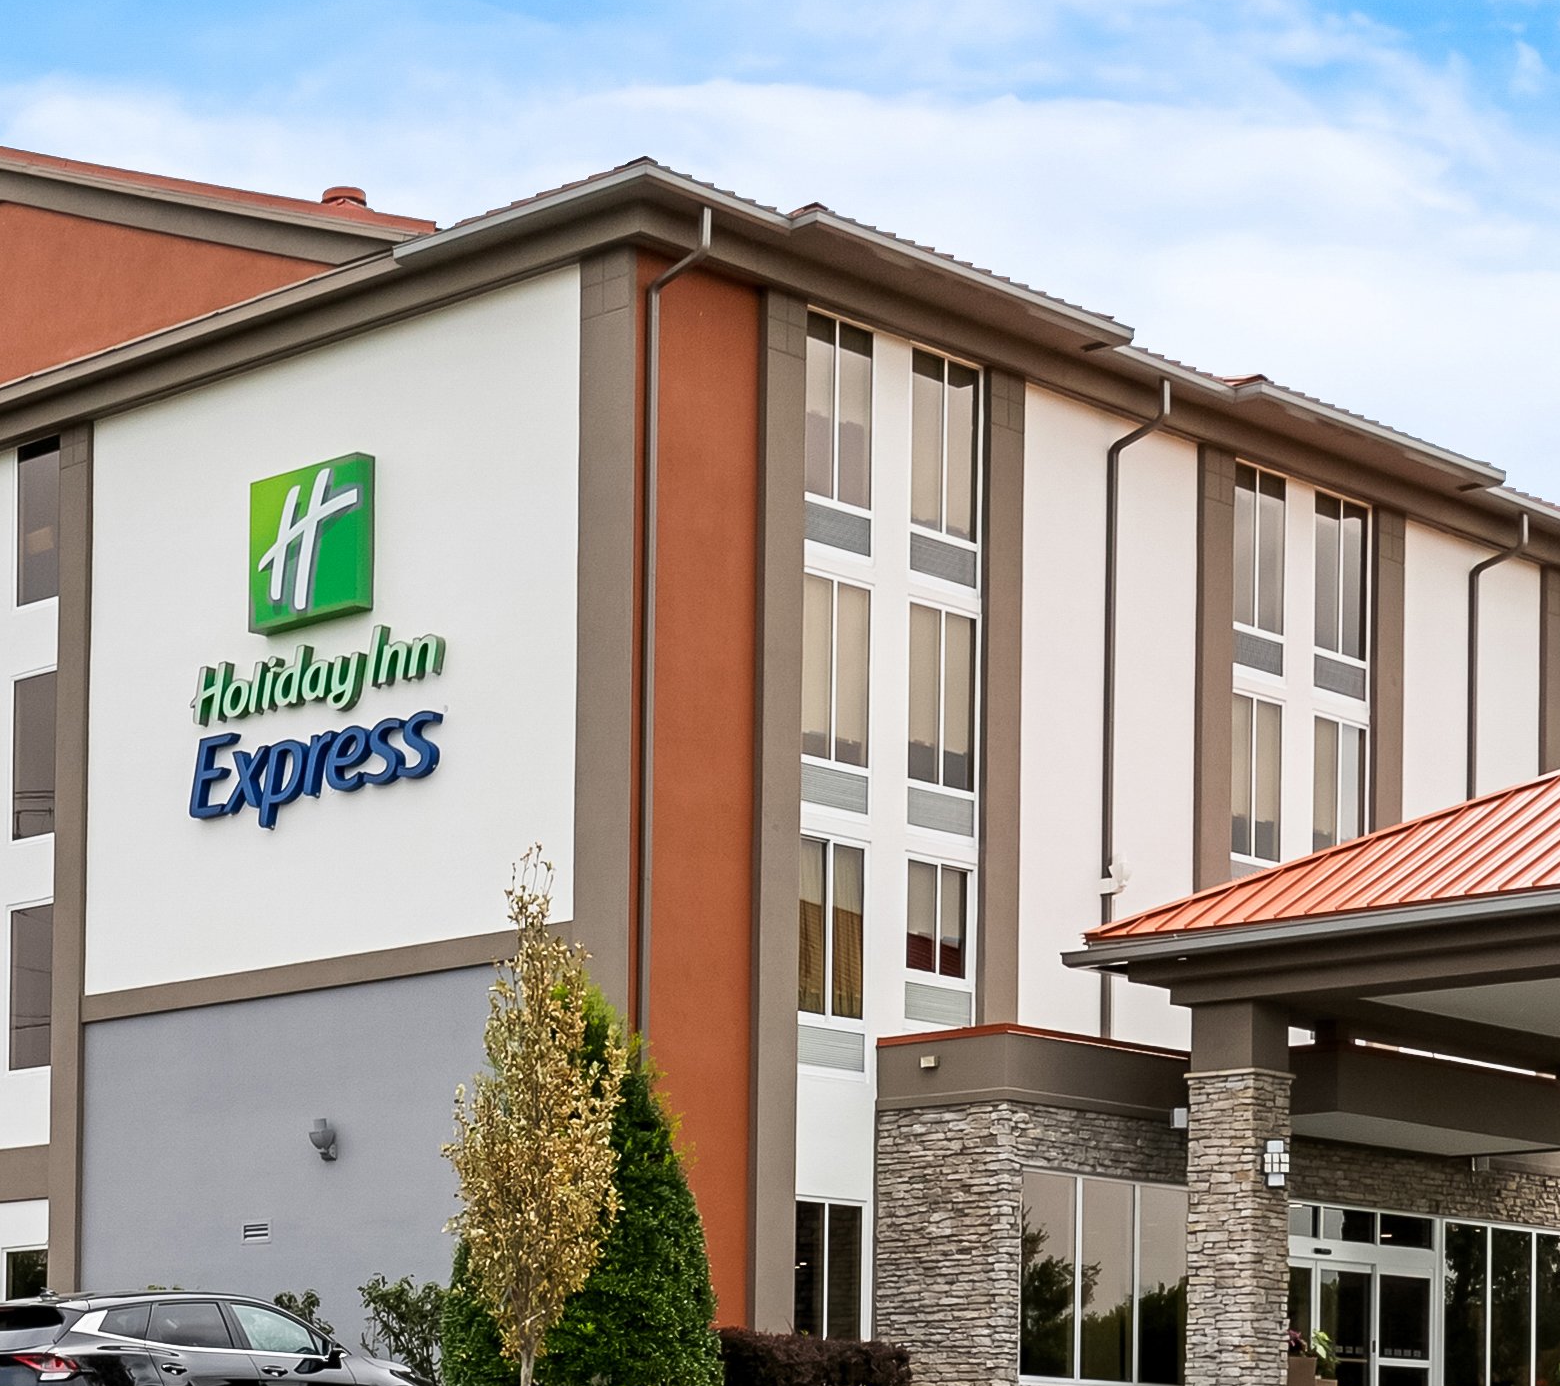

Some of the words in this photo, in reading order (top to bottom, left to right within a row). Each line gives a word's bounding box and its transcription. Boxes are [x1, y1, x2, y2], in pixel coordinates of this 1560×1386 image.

[189, 644, 367, 727] Holiday
[364, 624, 446, 689] Inn
[189, 710, 444, 830] Express
